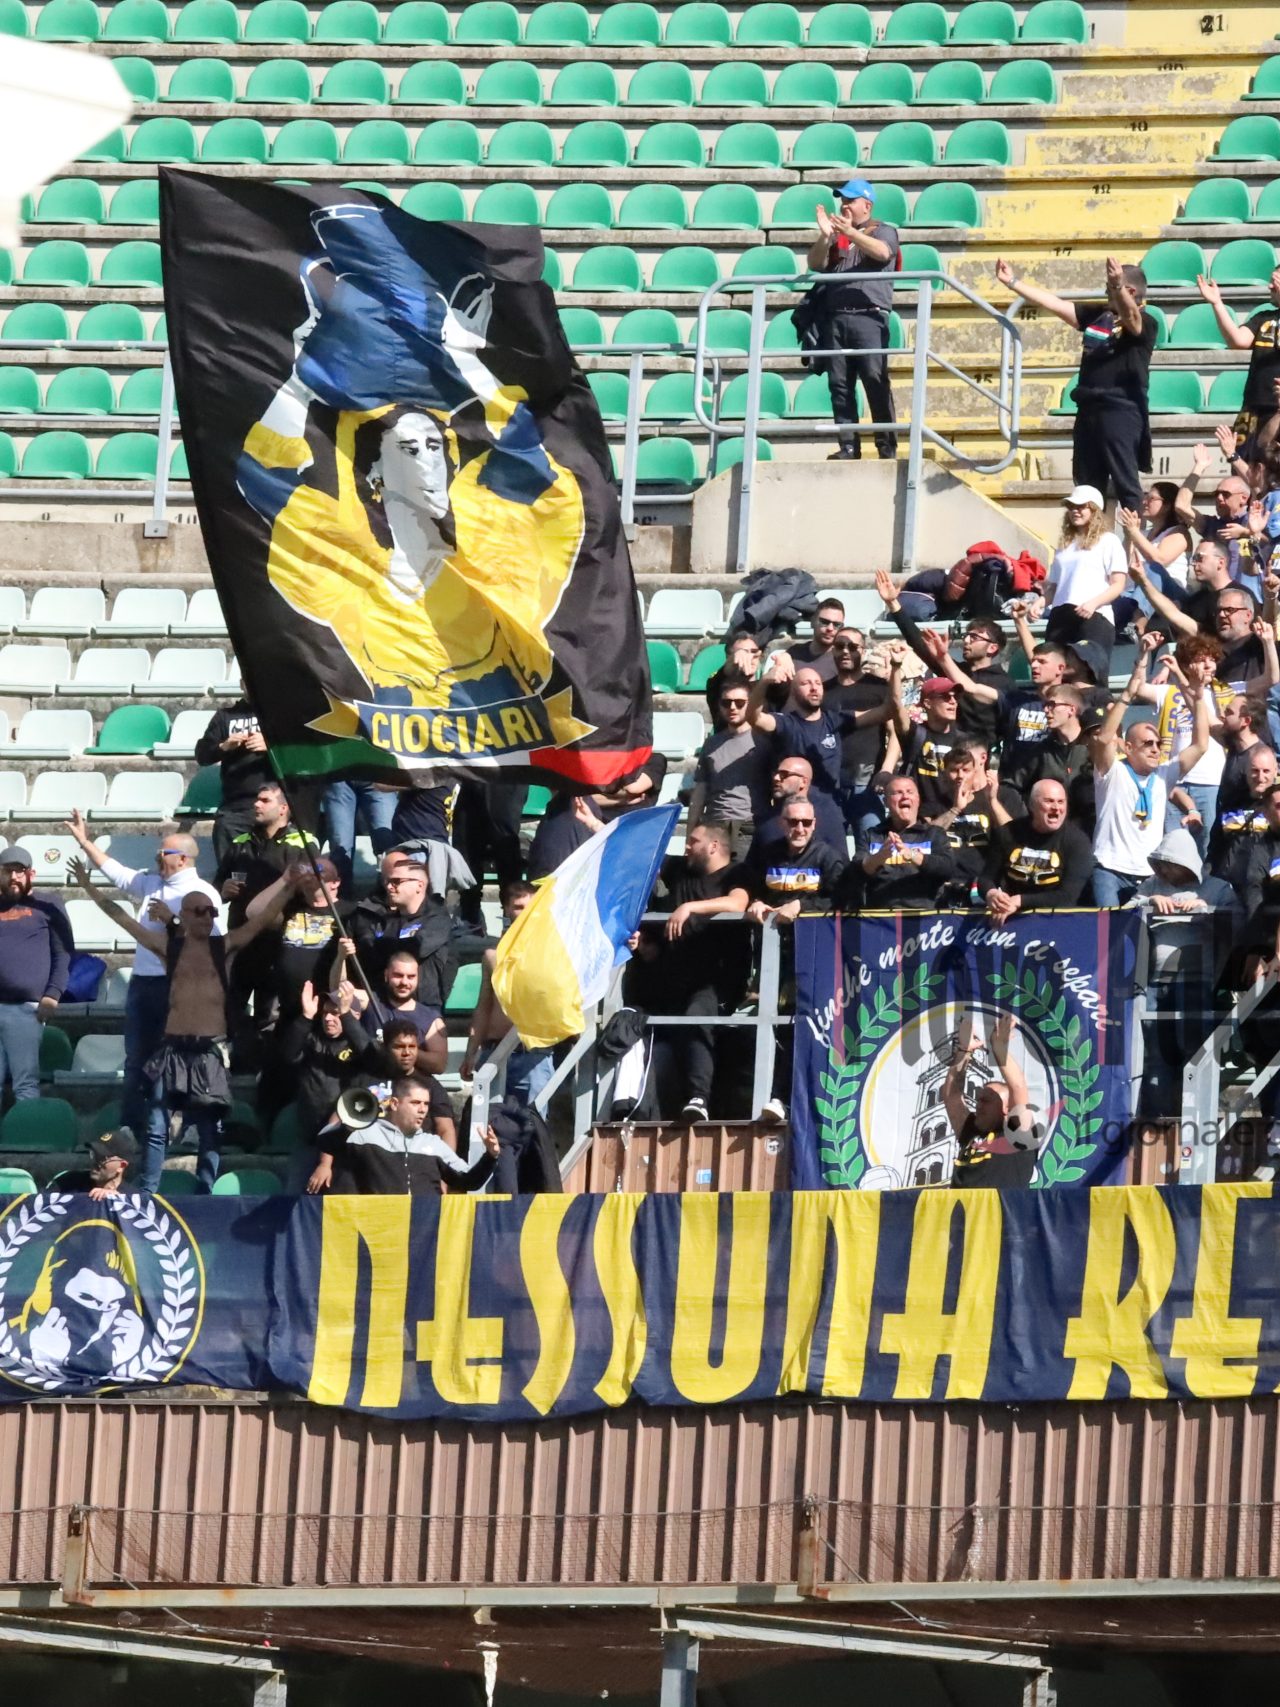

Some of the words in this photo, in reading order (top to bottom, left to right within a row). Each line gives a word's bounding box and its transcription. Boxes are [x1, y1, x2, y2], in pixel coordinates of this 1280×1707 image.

[371, 705, 542, 755] CIOCIARI
[879, 918, 956, 970] morte
[965, 926, 1017, 952] non
[1023, 939, 1057, 962] ci
[1052, 956, 1123, 1033] separi
